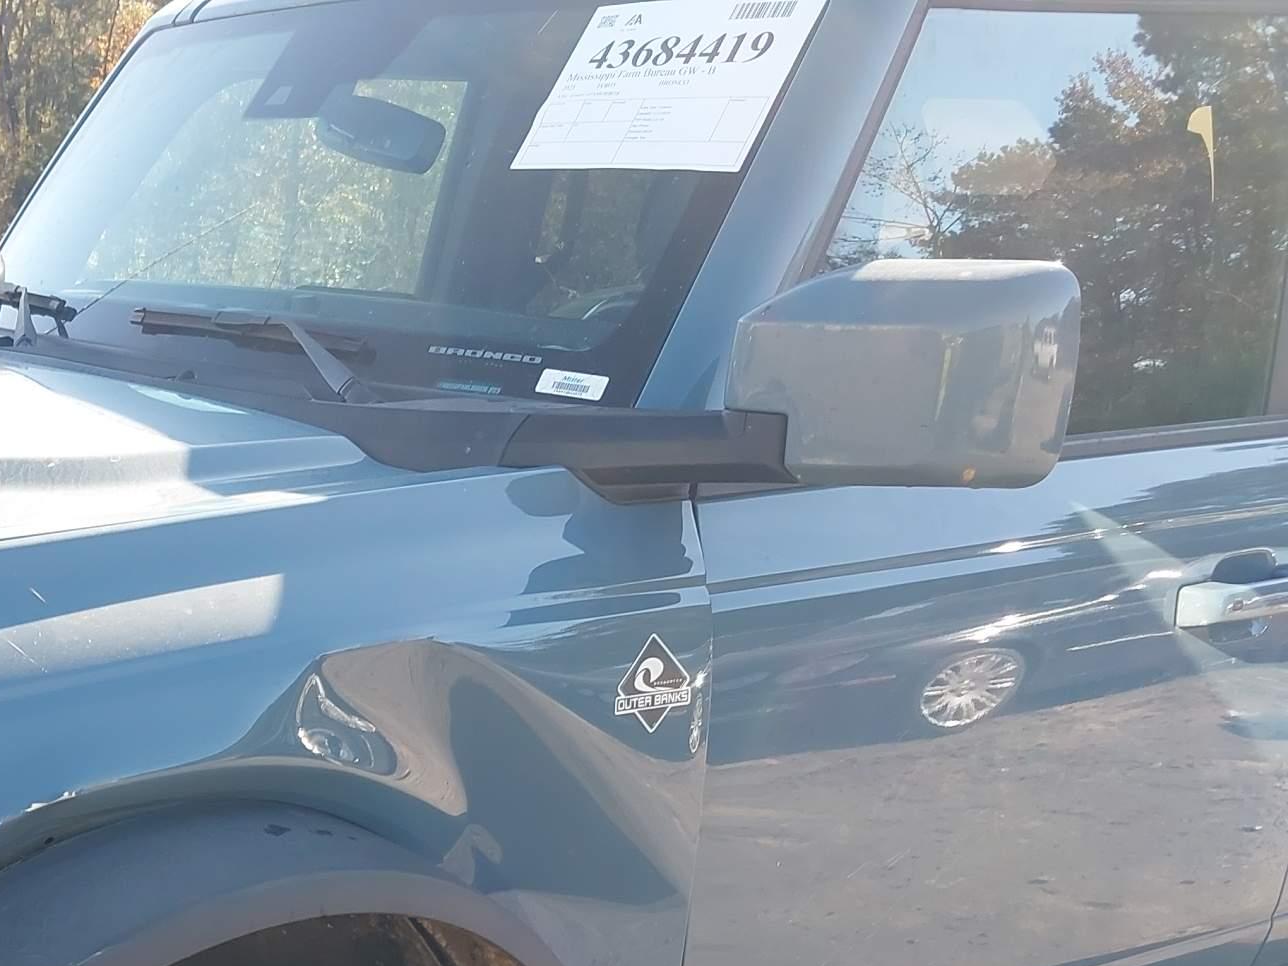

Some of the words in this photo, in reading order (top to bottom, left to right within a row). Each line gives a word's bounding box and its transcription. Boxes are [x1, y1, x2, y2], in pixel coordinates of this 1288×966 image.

[588, 31, 776, 70] 43684419
[566, 71, 616, 83] Mississippi
[617, 68, 642, 79] Farm
[643, 66, 676, 78] Bureau
[678, 65, 698, 76] GW
[428, 345, 543, 364] BRONCO
[618, 695, 652, 711] OUTER
[654, 690, 688, 706] BANKS
